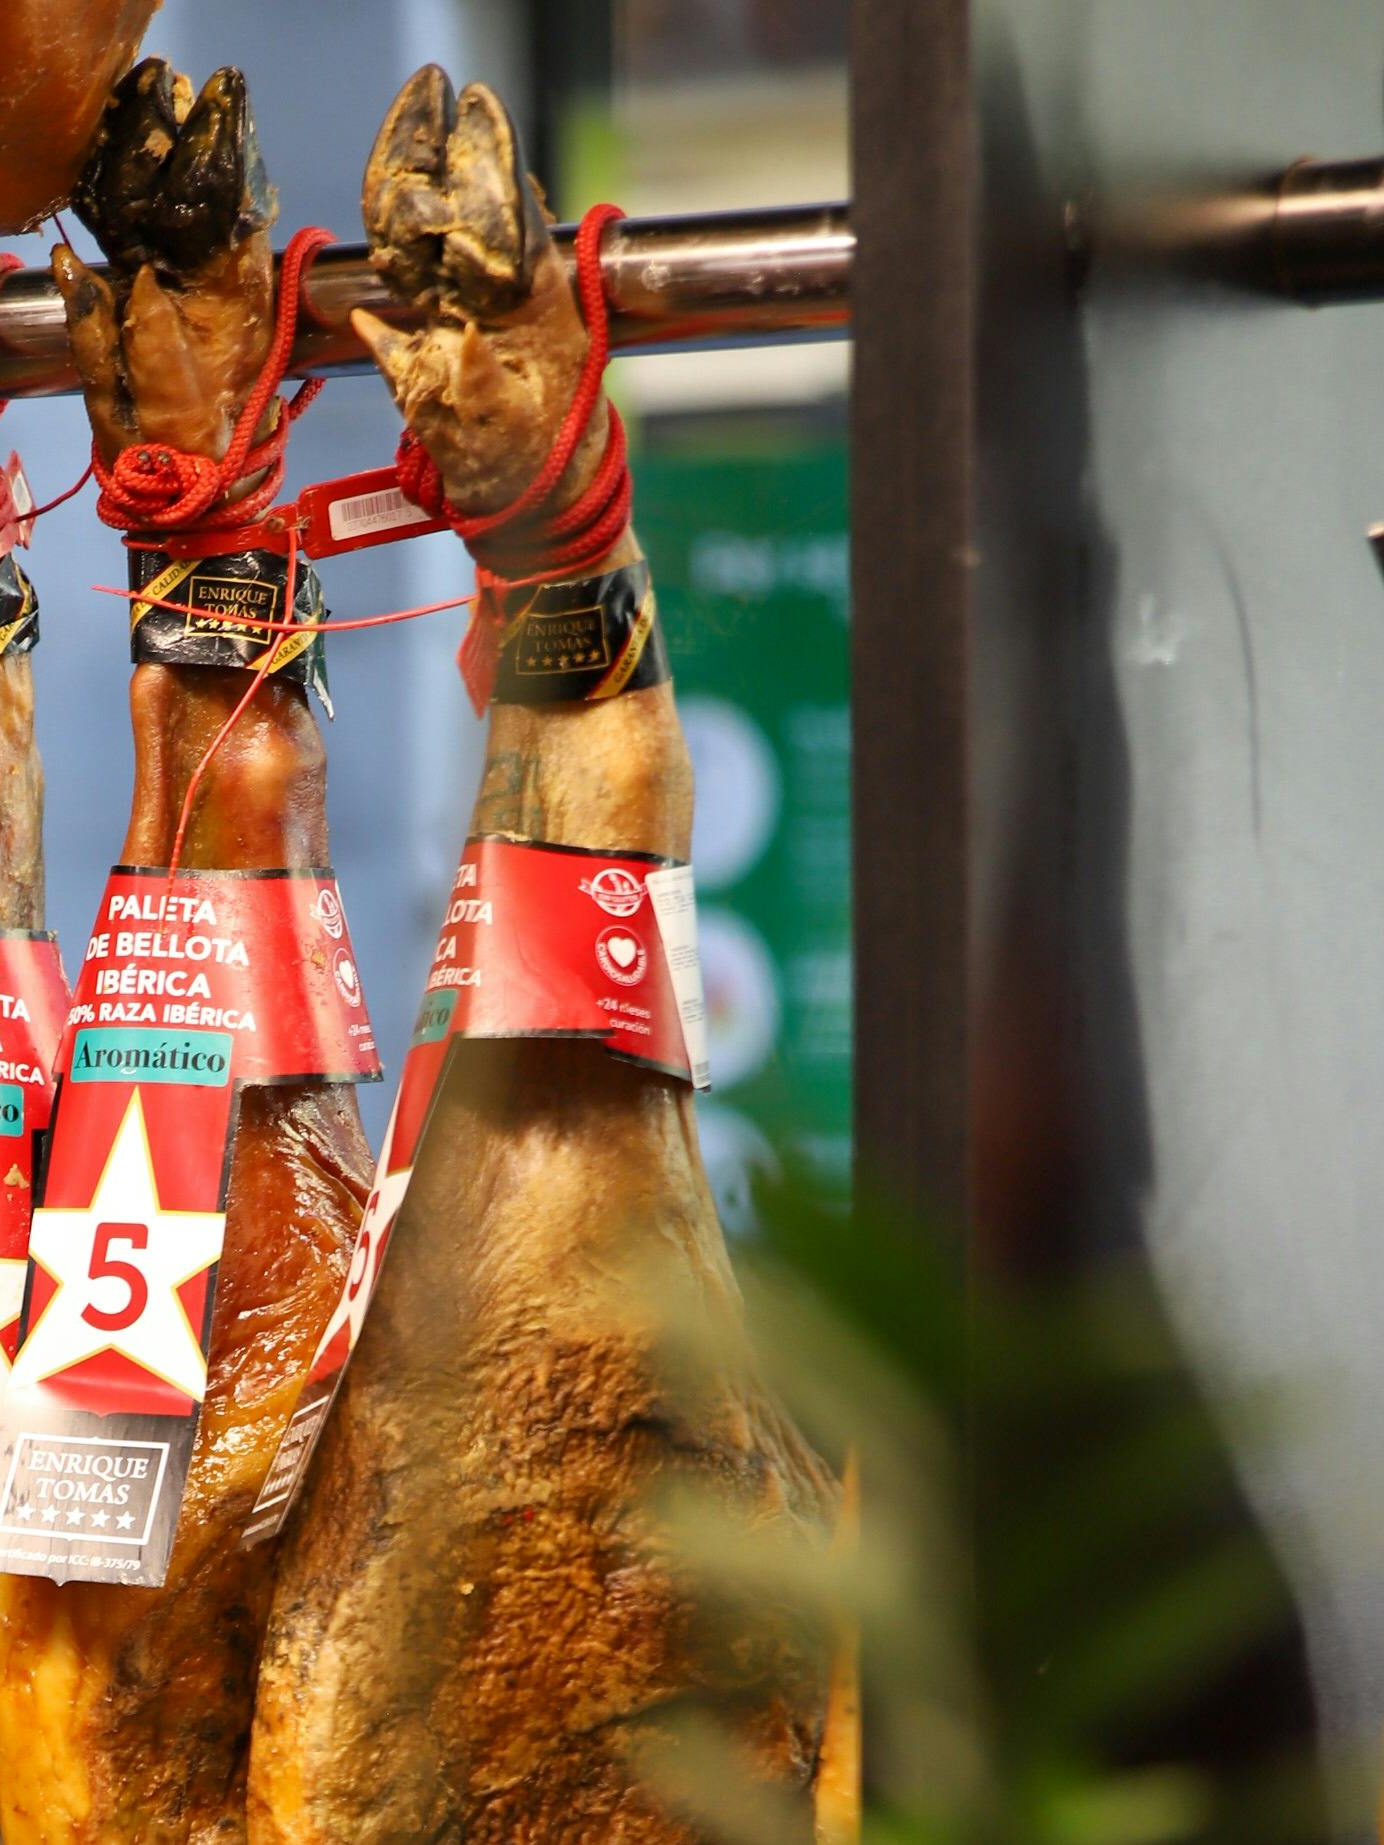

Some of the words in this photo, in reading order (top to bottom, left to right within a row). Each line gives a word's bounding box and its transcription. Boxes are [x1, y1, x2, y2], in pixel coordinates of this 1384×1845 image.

[198, 587, 268, 605] ENRIQUE
[108, 895, 217, 926] PALETA
[85, 936, 110, 960] DE
[116, 931, 249, 967] BELLOTA
[95, 963, 212, 999] IBÉRICA
[99, 1002, 157, 1023] RAZA
[162, 1001, 257, 1033] IBÉRICA
[73, 1042, 226, 1073] Aromático
[80, 1222, 149, 1331] 5
[27, 1449, 150, 1482] ENRIQUE
[36, 1477, 131, 1506] TOMAS
[47, 1554, 68, 1565] por
